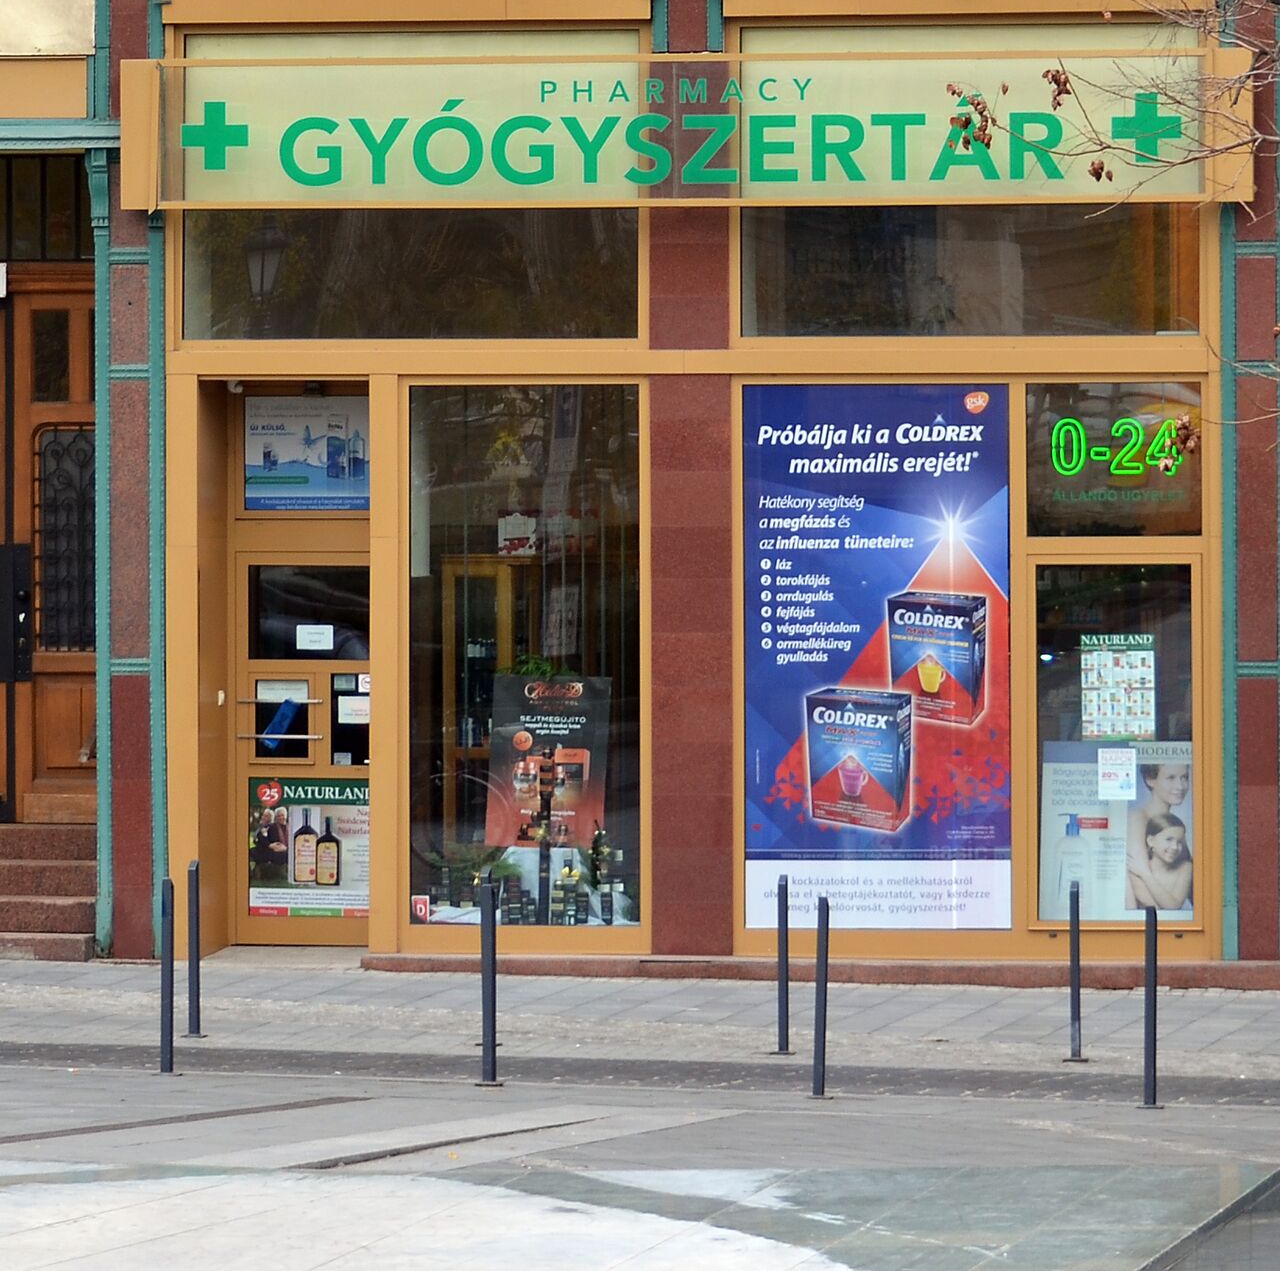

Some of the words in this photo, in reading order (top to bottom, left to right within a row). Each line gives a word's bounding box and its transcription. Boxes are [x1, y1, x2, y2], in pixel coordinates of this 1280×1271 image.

[540, 78, 812, 103] PHARMACY
[278, 92, 1065, 187] GYÓGYSZERTÁR
[966, 395, 986, 409] gsk
[757, 424, 846, 450] Próbálja
[851, 423, 872, 444] ki
[875, 429, 890, 444] a
[895, 423, 984, 444] COLDREX
[1051, 417, 1184, 476] 0-24
[789, 451, 899, 474] maximális
[759, 495, 816, 511] Hatékony
[817, 494, 864, 511] segítség
[759, 518, 768, 528] a
[770, 515, 836, 531] megfázás
[837, 515, 850, 528] és
[759, 539, 774, 549] az
[775, 535, 840, 549] influenza
[844, 535, 914, 549] tüneteire:
[775, 558, 792, 570] láz
[776, 574, 830, 588] torokfájás
[776, 590, 834, 604] orrdugulás
[776, 606, 815, 620] fejfájás
[893, 608, 964, 630] COLDREX
[776, 621, 860, 636] végtagfájdalom
[776, 637, 852, 651] orrmelléküreg
[1081, 634, 1153, 645] NATURLAND
[776, 650, 829, 665] gyulladás
[812, 706, 888, 729] COLDREX
[261, 788, 279, 800] 25
[791, 876, 859, 886] kockázatokról
[863, 876, 874, 886] és
[877, 878, 883, 886] a
[886, 876, 973, 886] mellékhatásokról
[764, 889, 800, 899] olvsa
[803, 889, 813, 899] el
[825, 889, 916, 901] betegtájékoztatót,
[919, 891, 943, 901] vagy
[813, 903, 885, 913] kelőorvosát,
